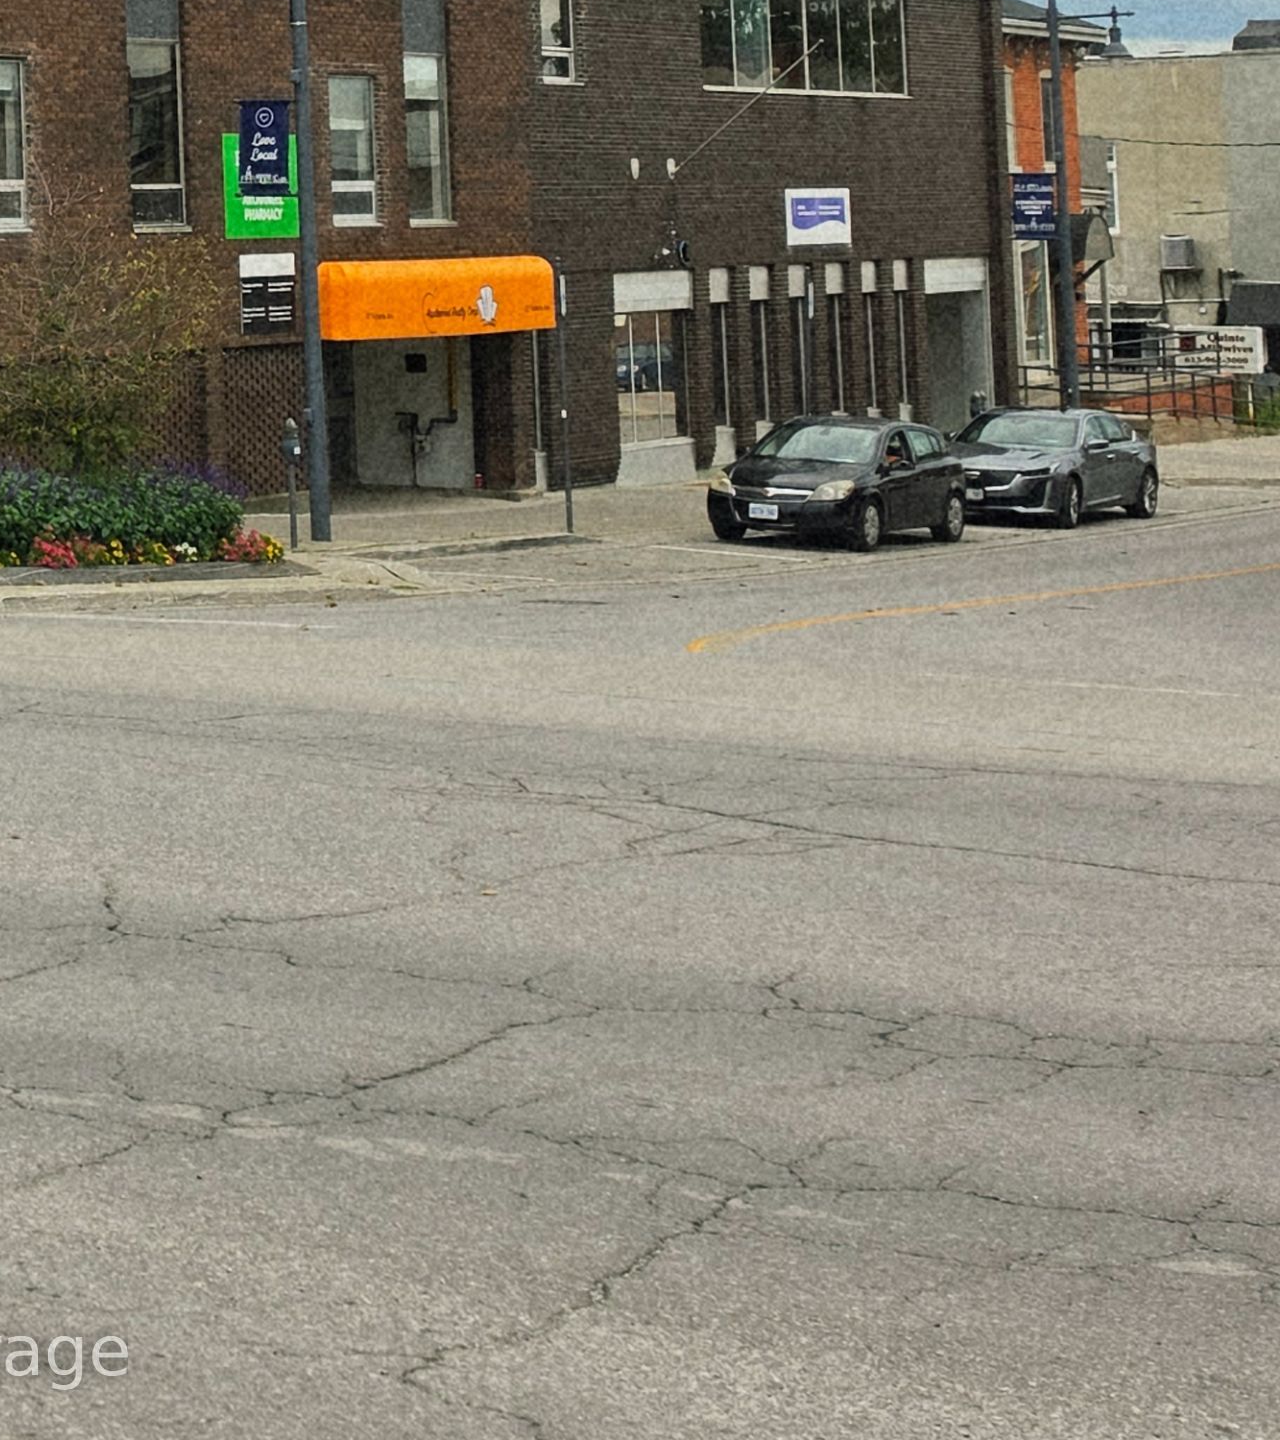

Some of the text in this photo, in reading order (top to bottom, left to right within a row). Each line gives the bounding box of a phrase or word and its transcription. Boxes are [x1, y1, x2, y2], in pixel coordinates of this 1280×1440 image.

[251, 131, 276, 146] Love
[250, 148, 278, 161] Local
[244, 208, 283, 221] PHARMACY
